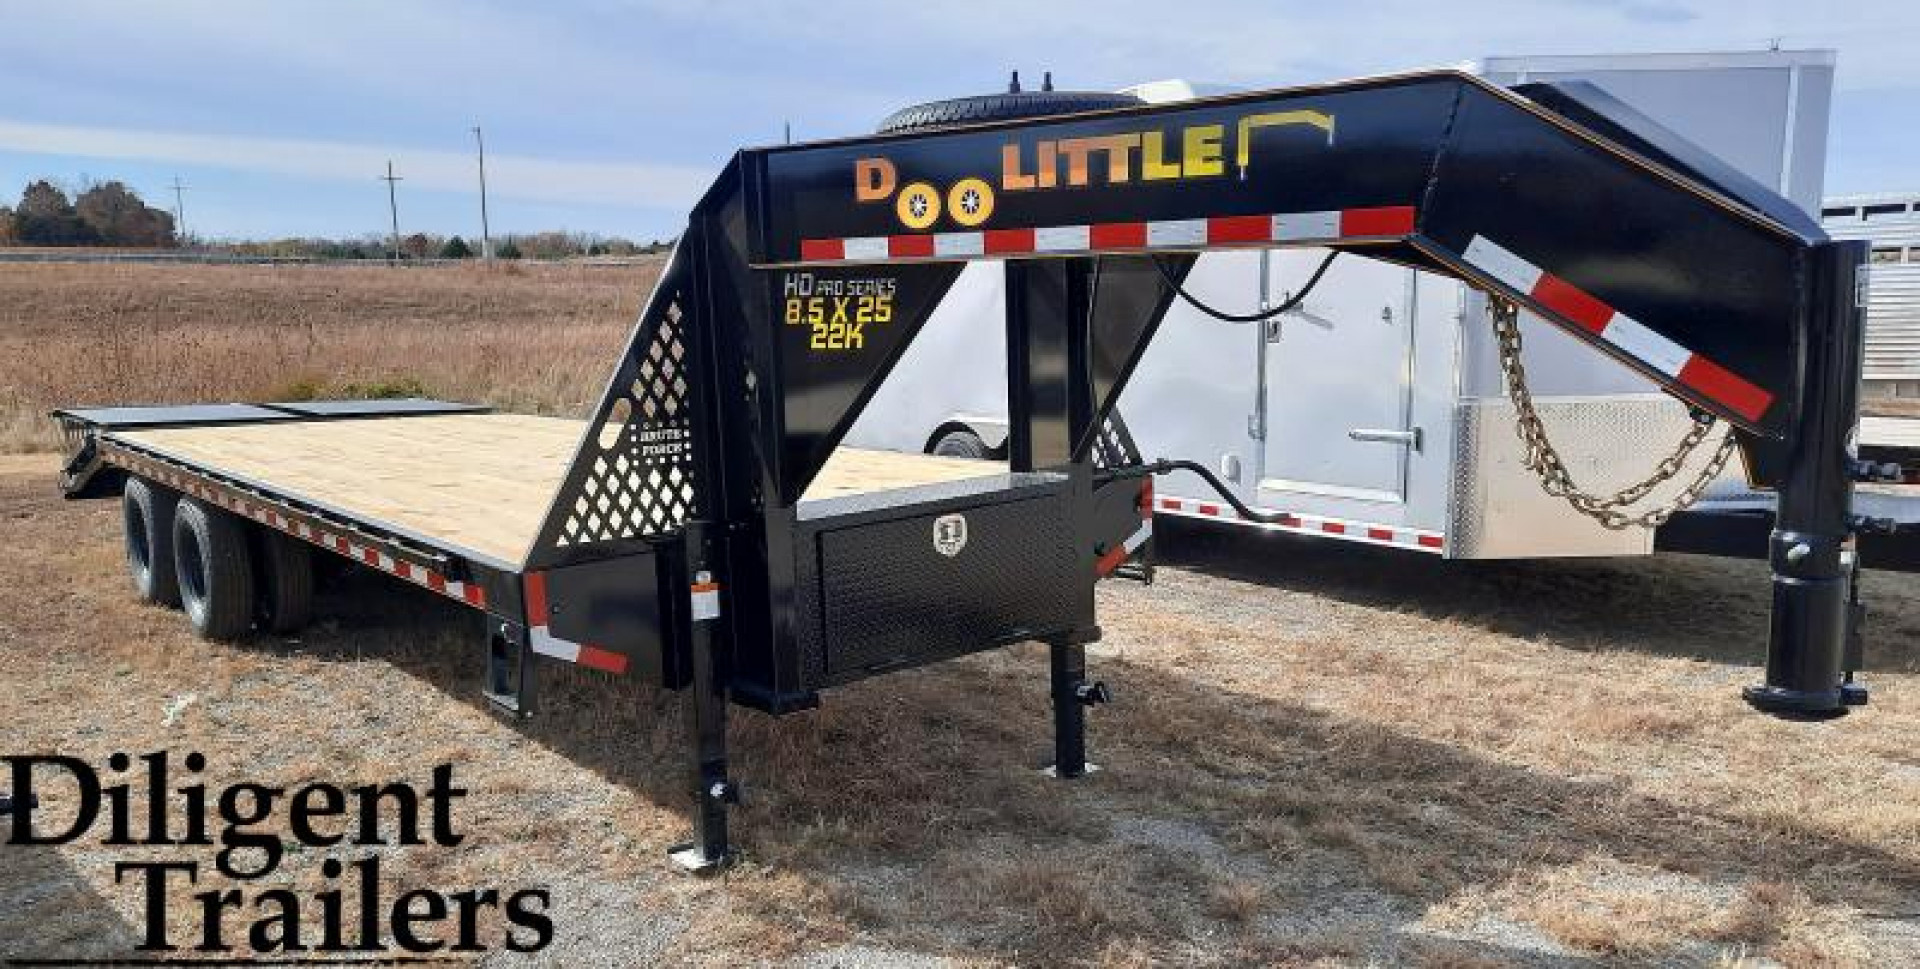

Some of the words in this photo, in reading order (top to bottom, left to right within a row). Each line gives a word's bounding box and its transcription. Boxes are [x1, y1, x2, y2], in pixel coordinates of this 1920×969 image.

[854, 124, 1225, 229] DOOLITTLE
[784, 273, 813, 297] HD
[816, 280, 843, 296] PRO
[846, 278, 896, 296] SERIES
[785, 299, 824, 324] 8.5
[856, 297, 892, 322] 25
[810, 323, 864, 349] 22K
